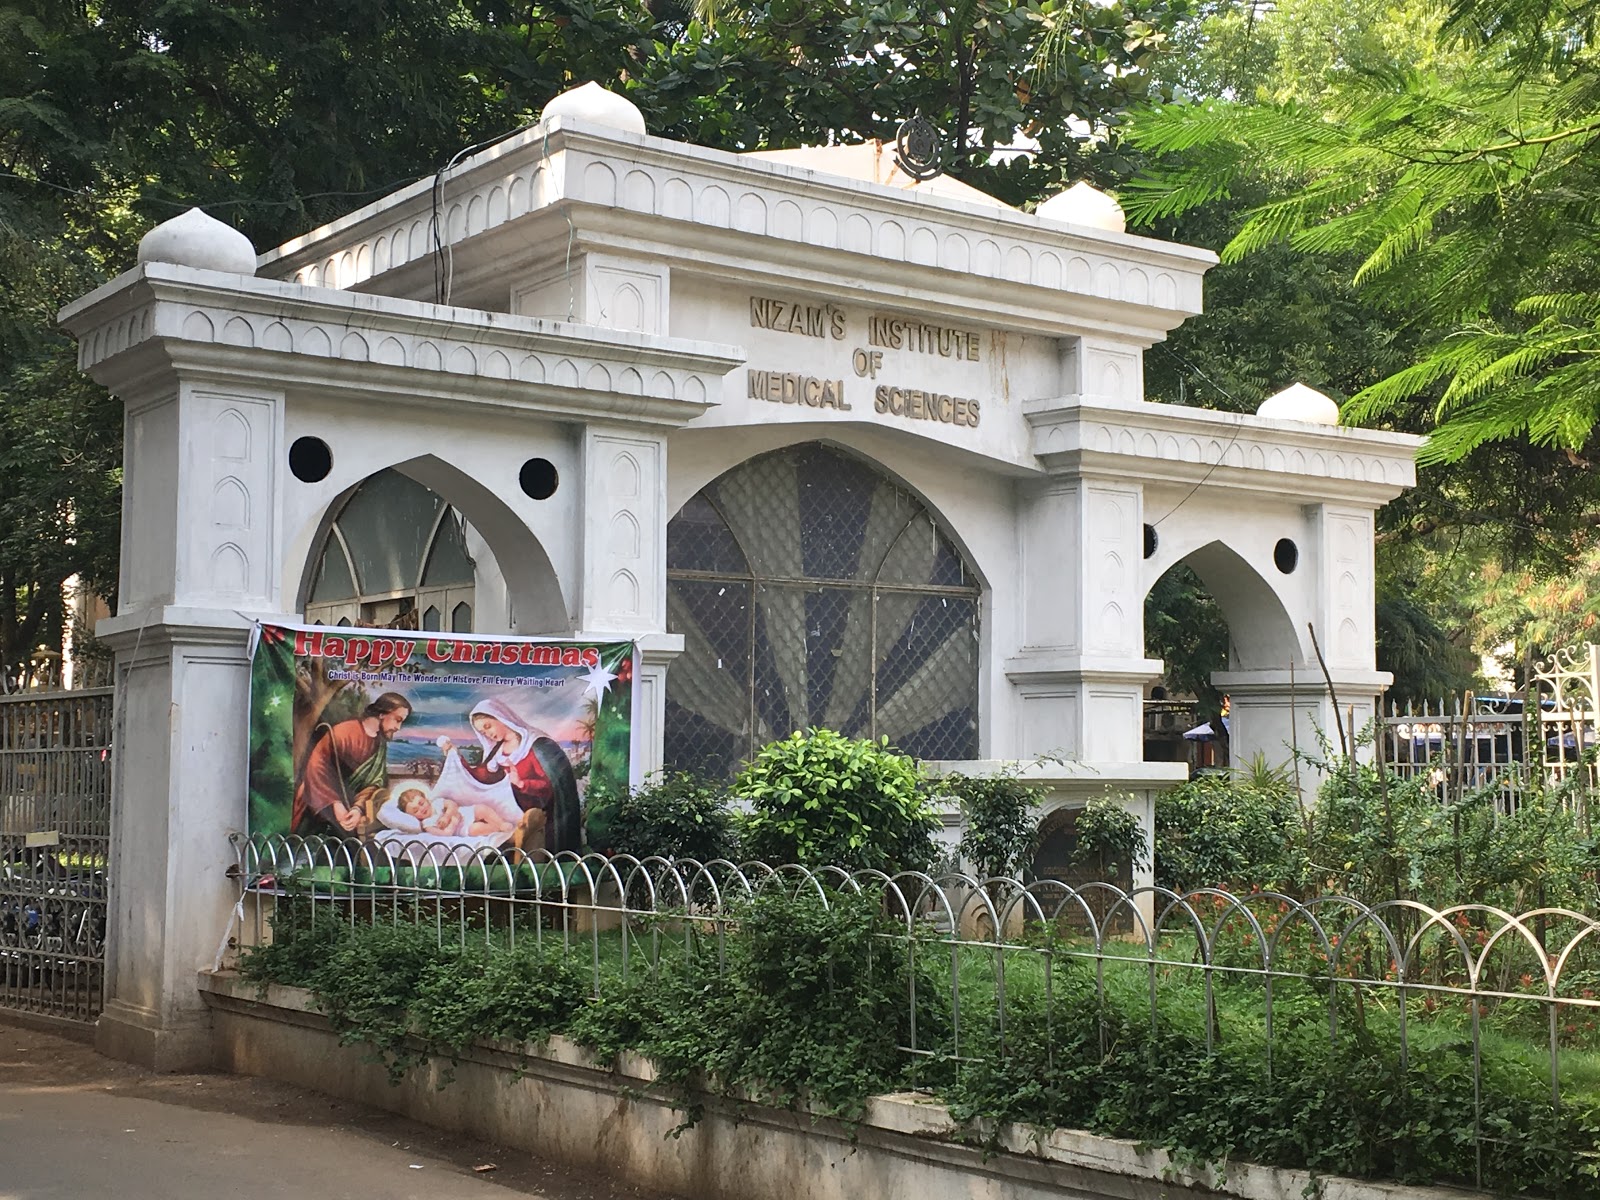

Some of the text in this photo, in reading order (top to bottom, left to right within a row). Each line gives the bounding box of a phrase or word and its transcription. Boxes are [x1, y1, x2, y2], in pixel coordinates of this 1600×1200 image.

[749, 296, 981, 362] NIZAM'S INSTITUTE
[852, 347, 884, 379] OF
[747, 369, 981, 428] MEDICAL SCIENCES
[293, 631, 599, 667] Happy Christmas
[328, 670, 351, 680] Christ
[361, 672, 380, 681] Born
[380, 672, 397, 683] May
[399, 673, 412, 682] The
[414, 674, 442, 683] Wonder
[443, 675, 451, 683] of
[482, 676, 494, 684] Fill
[495, 677, 515, 687] Every
[516, 677, 544, 687] Waiting
[545, 678, 565, 687] Heart
